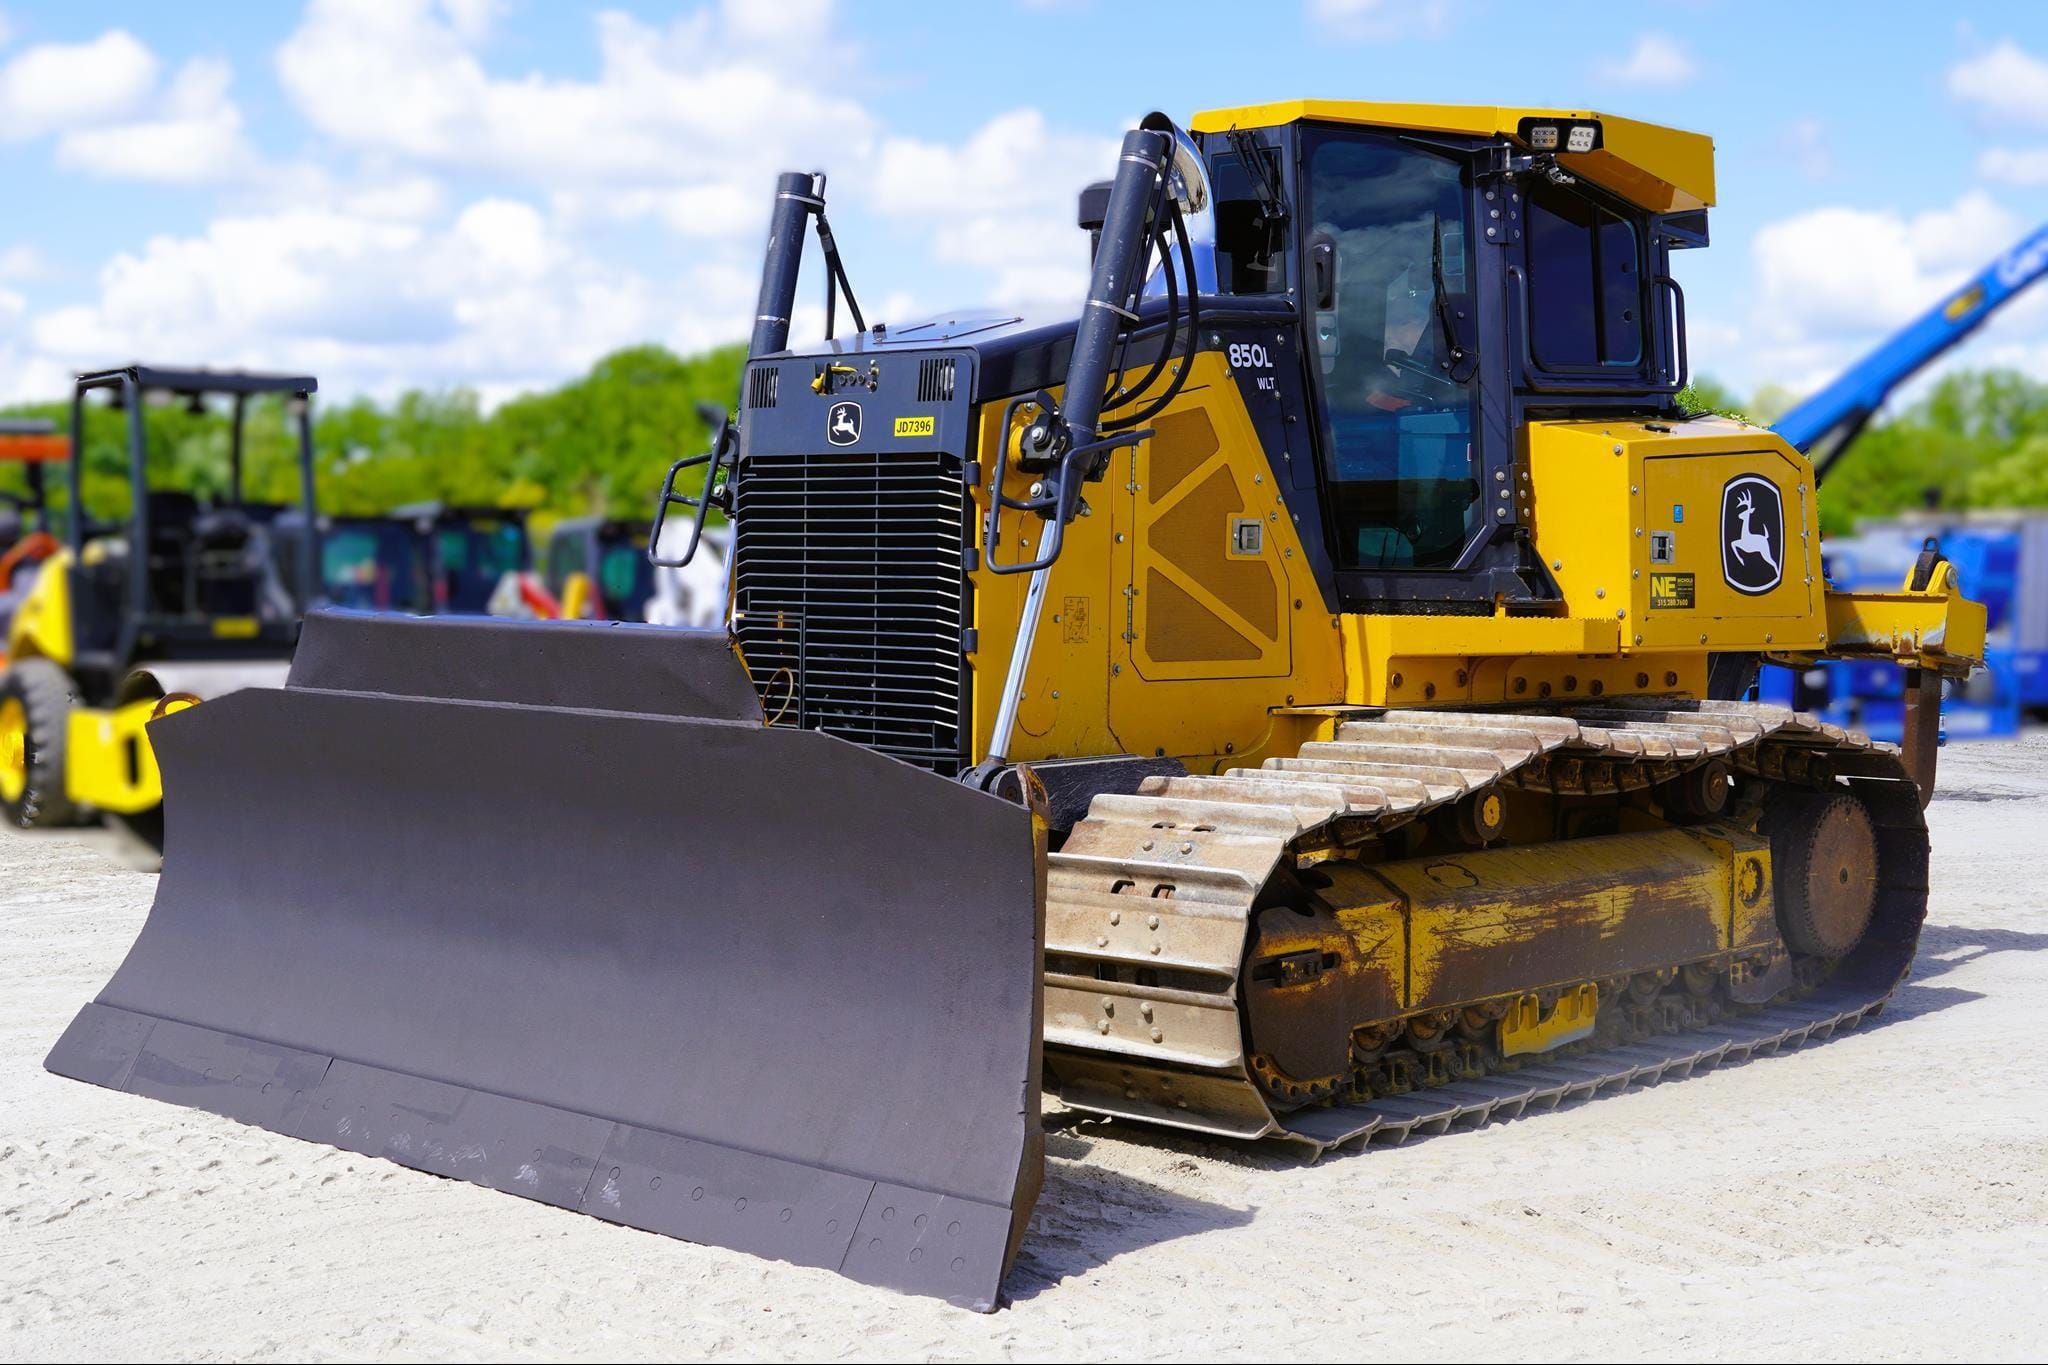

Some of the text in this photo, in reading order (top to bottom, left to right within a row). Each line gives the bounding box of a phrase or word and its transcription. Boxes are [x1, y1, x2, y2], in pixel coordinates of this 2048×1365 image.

[1229, 343, 1274, 368] 850L
[1256, 377, 1275, 390] WLT
[896, 420, 931, 433] JD7396
[1651, 576, 1677, 597] NE
